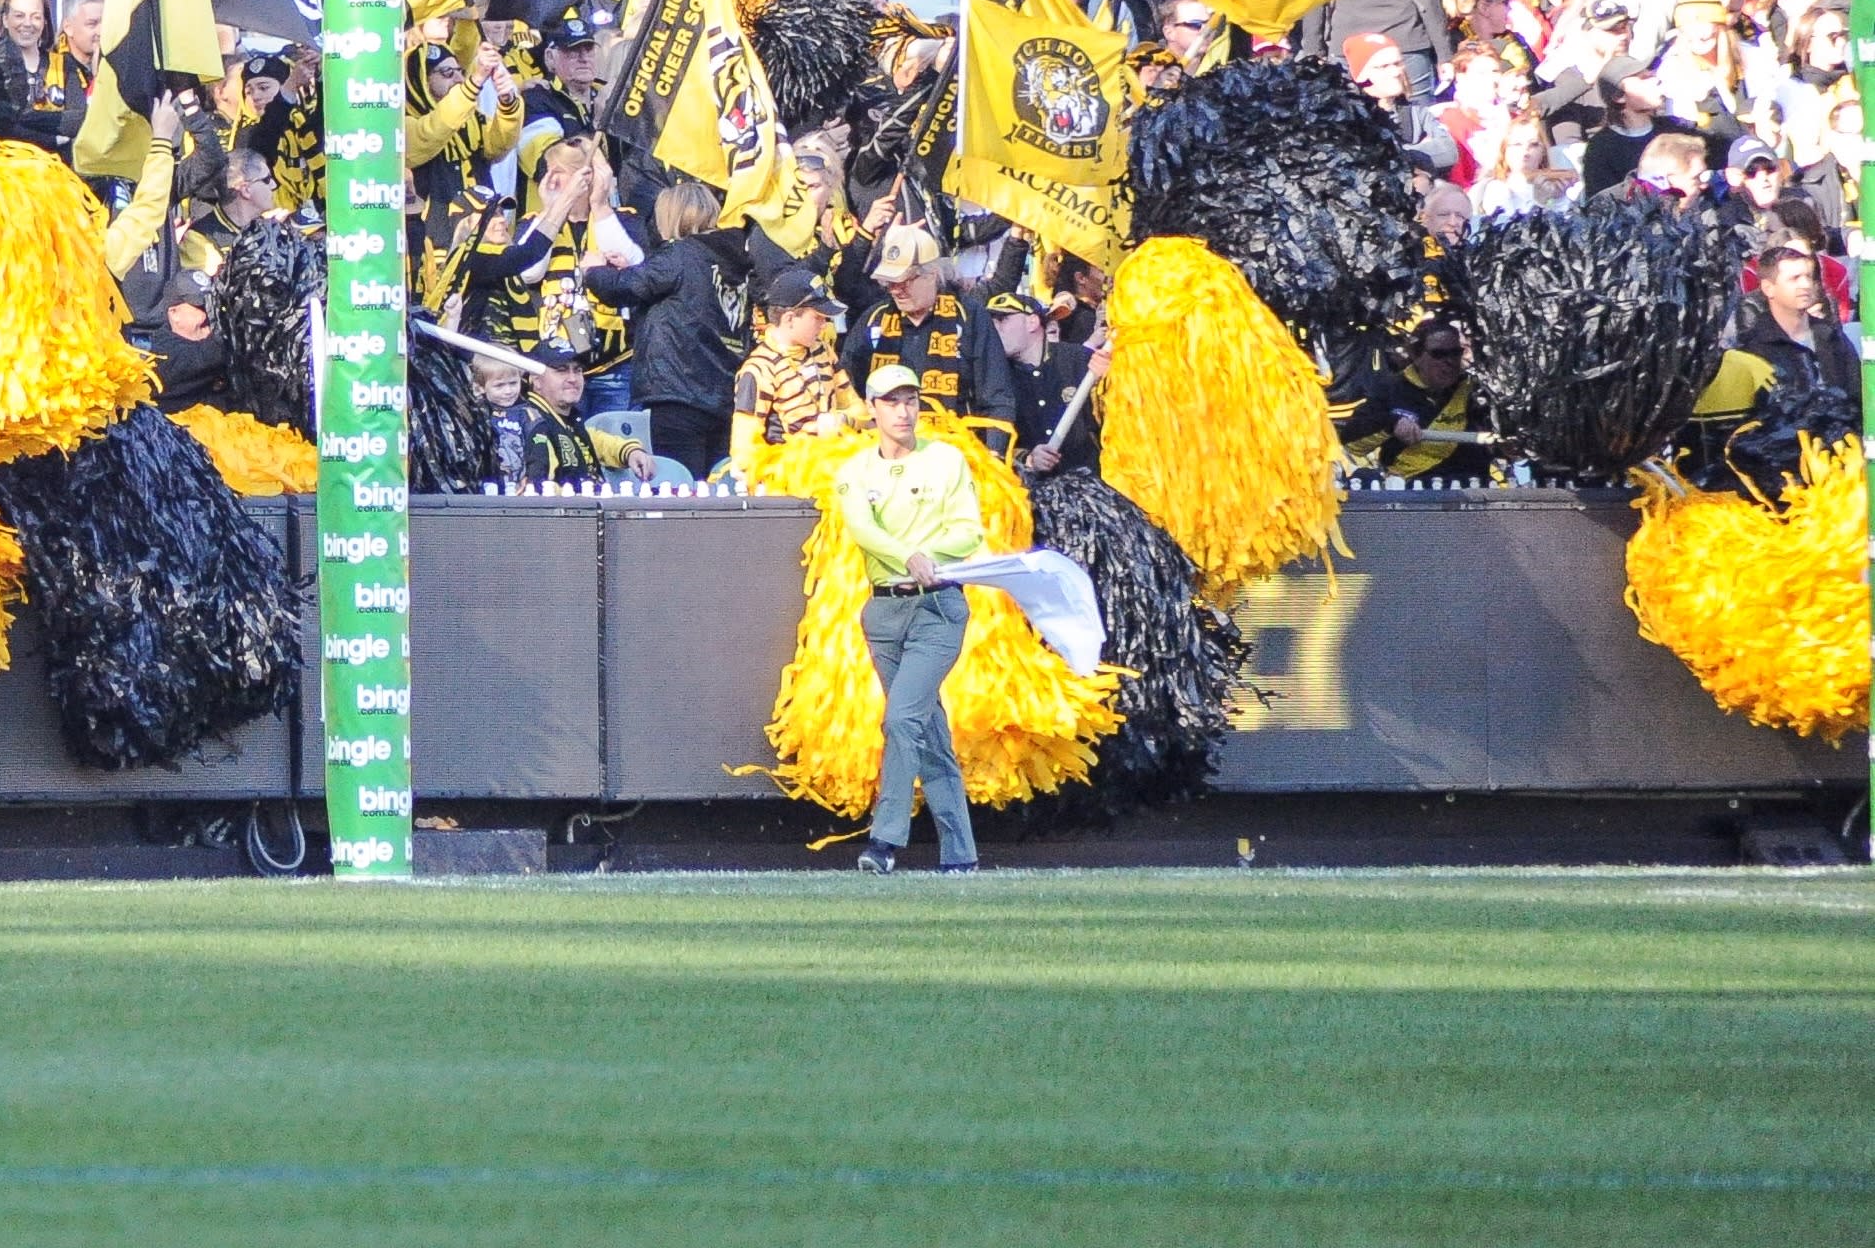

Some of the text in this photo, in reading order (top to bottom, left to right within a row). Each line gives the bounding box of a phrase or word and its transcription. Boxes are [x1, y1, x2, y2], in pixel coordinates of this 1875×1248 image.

[623, 28, 671, 118] OFFICIAL
[655, 27, 695, 98] CHEER
[1022, 130, 1095, 159] TIGERS
[324, 532, 388, 564] bingle
[325, 634, 390, 665] bingle
